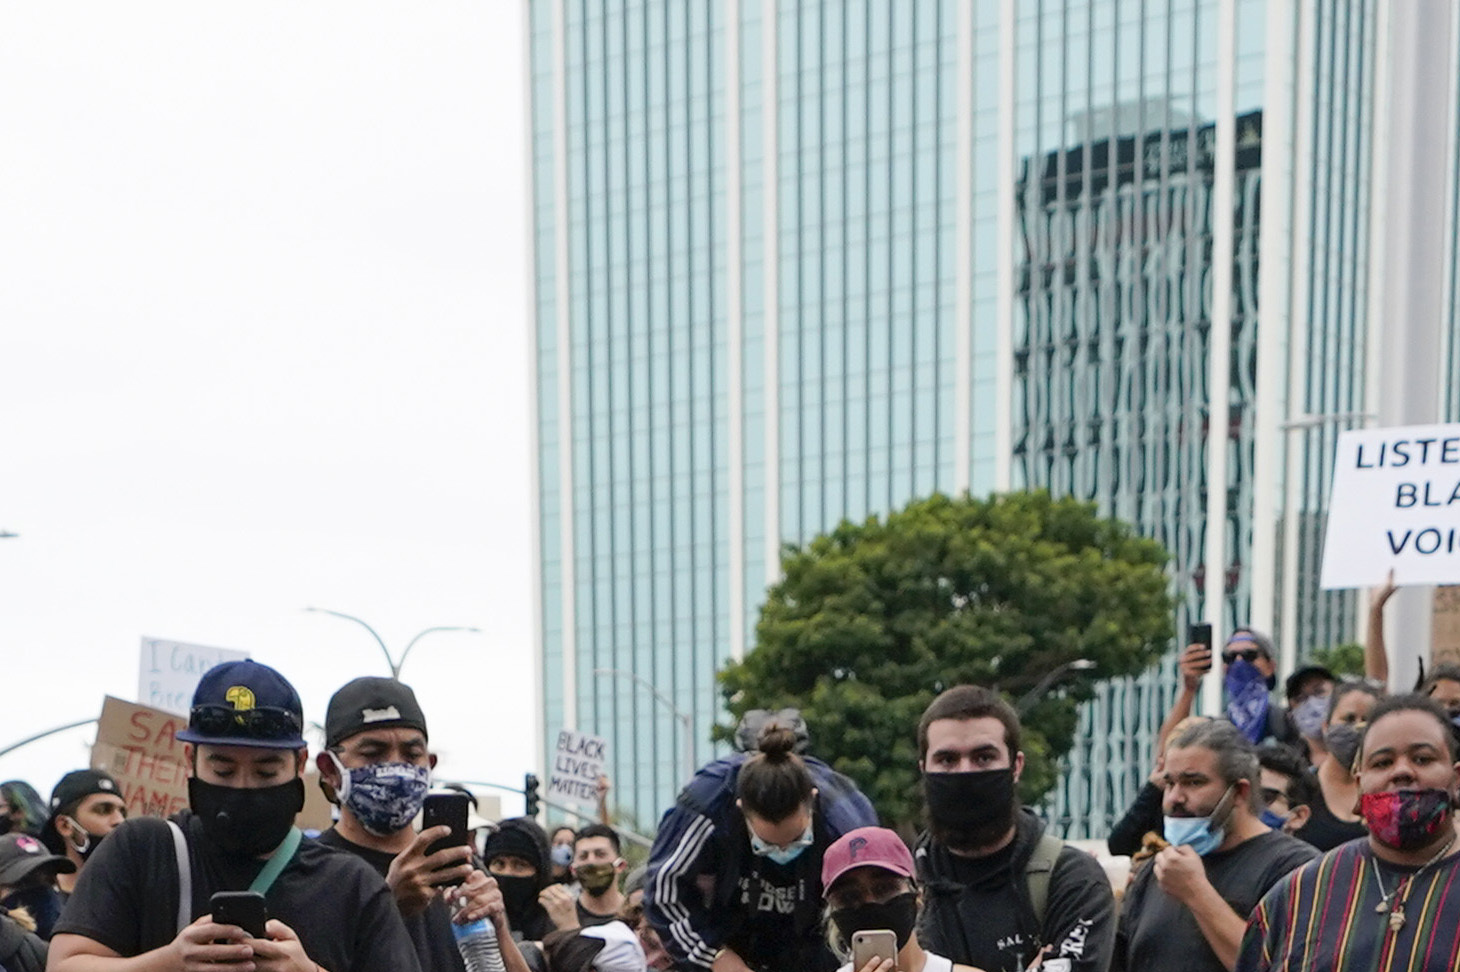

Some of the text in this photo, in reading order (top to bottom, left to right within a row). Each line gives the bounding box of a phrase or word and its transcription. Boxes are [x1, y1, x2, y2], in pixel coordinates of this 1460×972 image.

[149, 641, 162, 673] I
[128, 711, 188, 751] SA
[557, 731, 606, 762] BLACK
[556, 755, 600, 780] LIVES
[549, 776, 600, 801] MATTER
